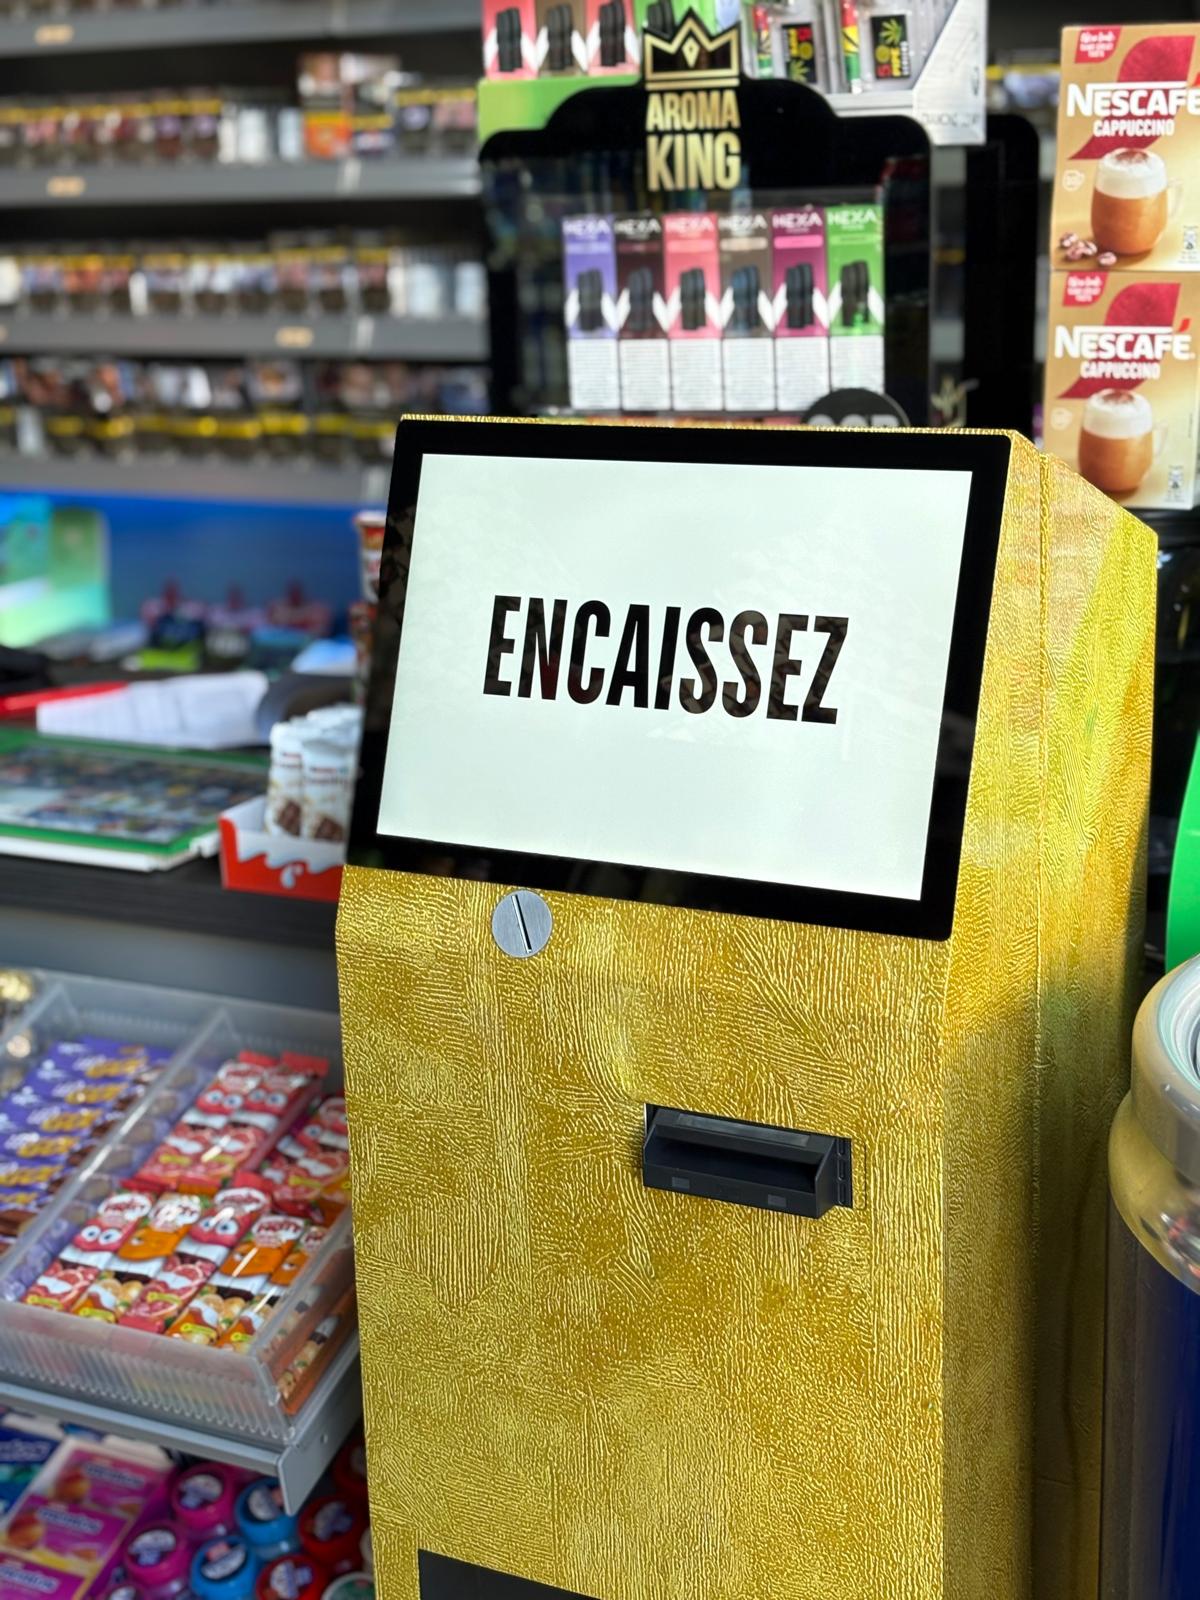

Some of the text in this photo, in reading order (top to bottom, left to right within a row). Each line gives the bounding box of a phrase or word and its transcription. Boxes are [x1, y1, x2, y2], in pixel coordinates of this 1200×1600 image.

[645, 89, 740, 132] AROMA
[1093, 118, 1175, 137] CAPPUCCINO
[646, 131, 741, 191] KING
[665, 217, 713, 233] HEXA
[719, 214, 768, 231] HEXA
[772, 211, 822, 229] HEXA
[827, 208, 877, 226] HEXA
[562, 218, 610, 235] HEXA
[614, 218, 661, 235] HEXA
[1054, 318, 1192, 360] NESCAFÉ
[1080, 360, 1161, 379] CAPPUCCINO
[483, 594, 849, 725] ENCAISSEZ
